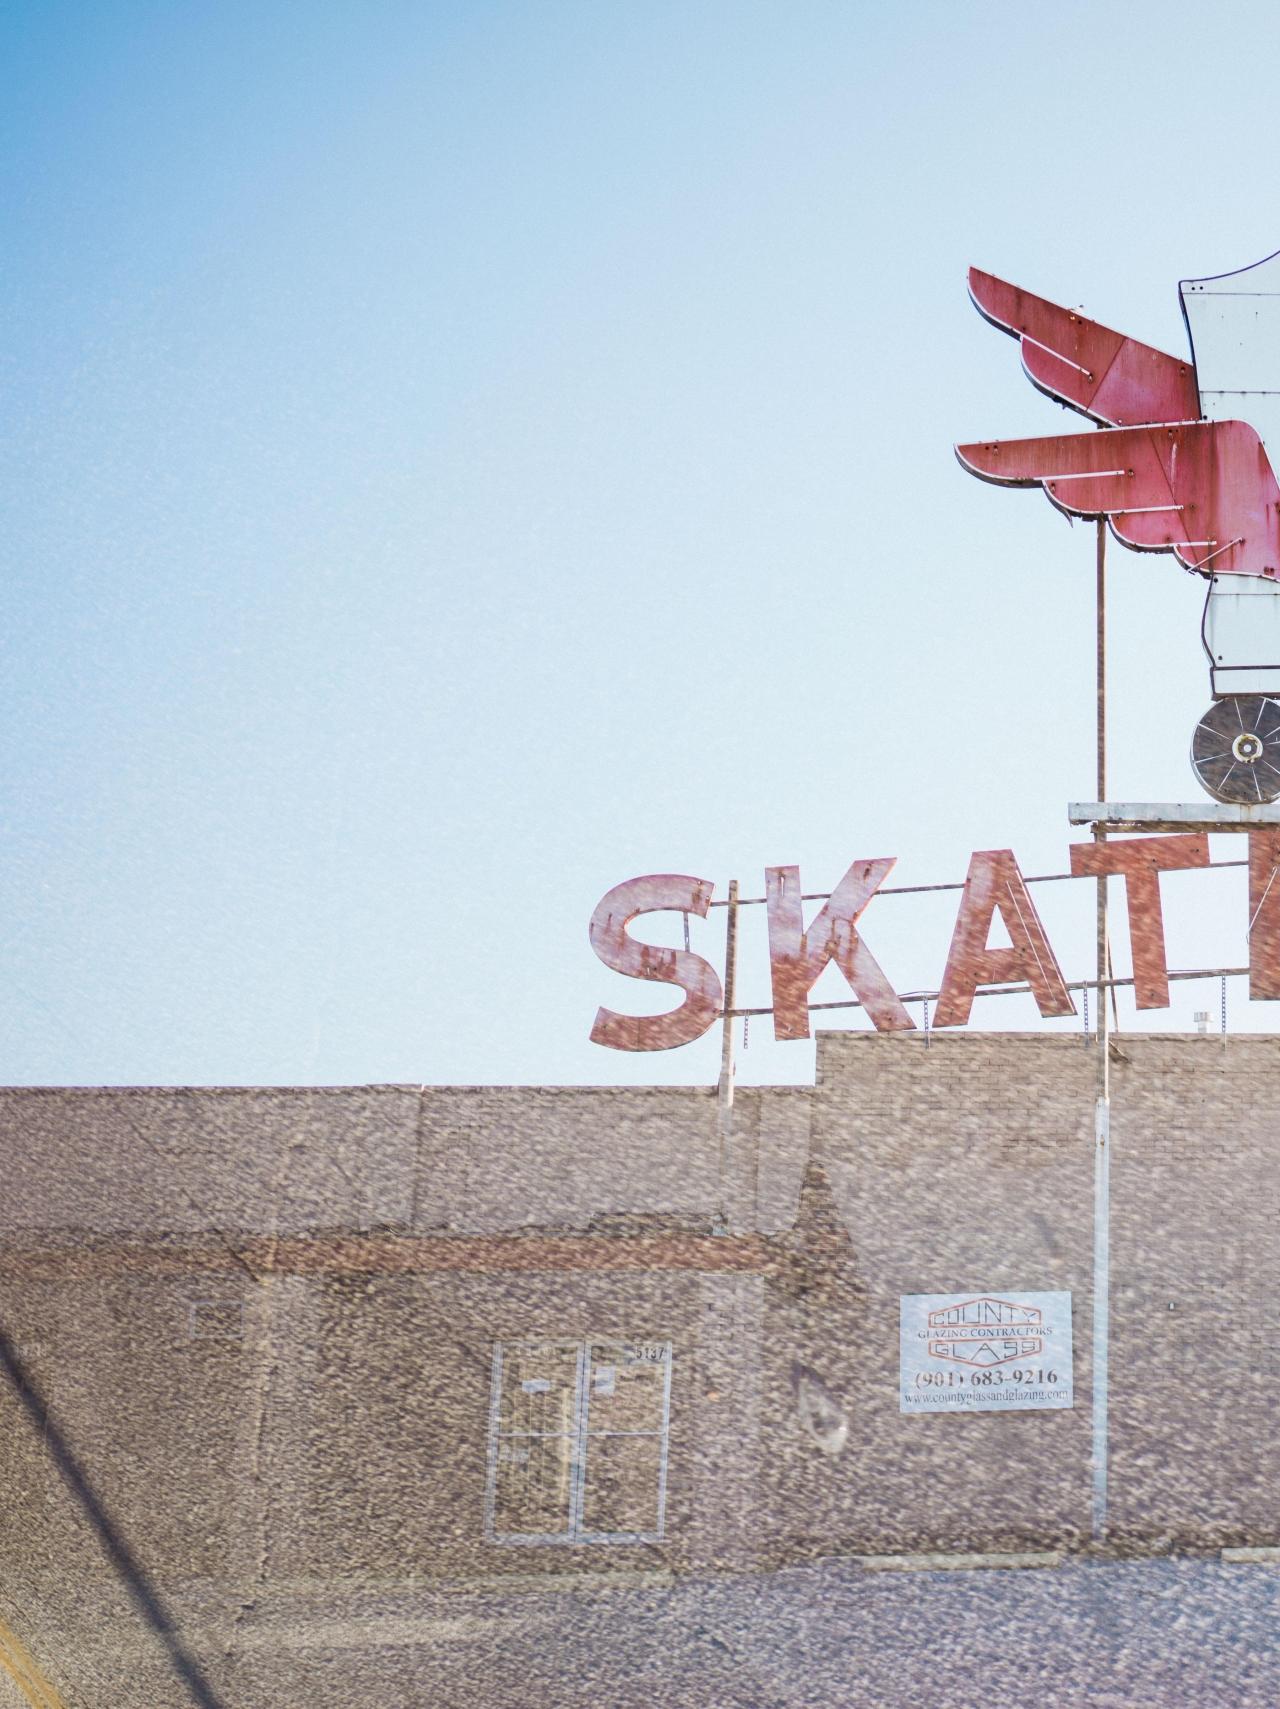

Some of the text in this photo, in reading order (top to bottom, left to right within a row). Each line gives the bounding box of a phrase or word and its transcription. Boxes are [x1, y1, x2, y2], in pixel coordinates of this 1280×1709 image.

[933, 1301, 1037, 1325] COUNTY
[917, 1326, 1053, 1339] GLAZING CONTRACTORS
[934, 1341, 1036, 1361] GLASS
[915, 1368, 1058, 1389] (901) 683-9216
[904, 1388, 1068, 1406] www.countyglassandglazing.com
